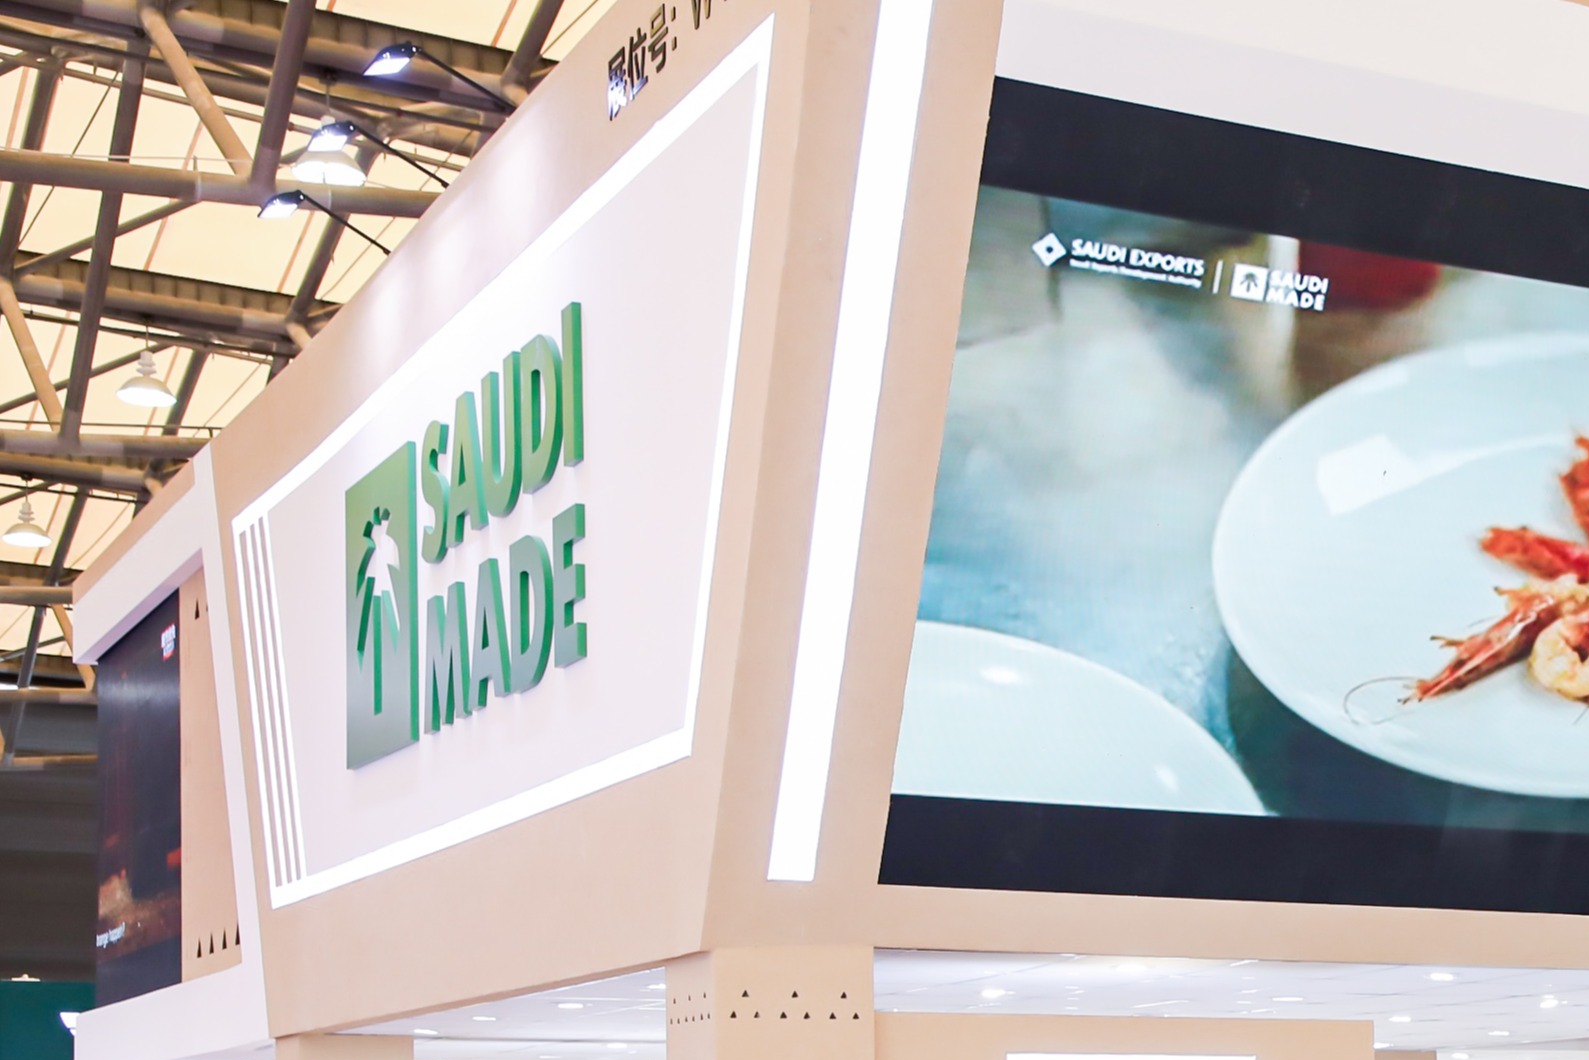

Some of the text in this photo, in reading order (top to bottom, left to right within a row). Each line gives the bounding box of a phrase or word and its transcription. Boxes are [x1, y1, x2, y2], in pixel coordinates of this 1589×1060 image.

[1071, 238, 1127, 263] SAUDI
[1129, 248, 1205, 276] EXPORTS
[1266, 287, 1326, 311] MADE
[1270, 270, 1329, 294] SAUDI
[421, 301, 584, 564] SAUDI
[424, 502, 588, 735] MADE
